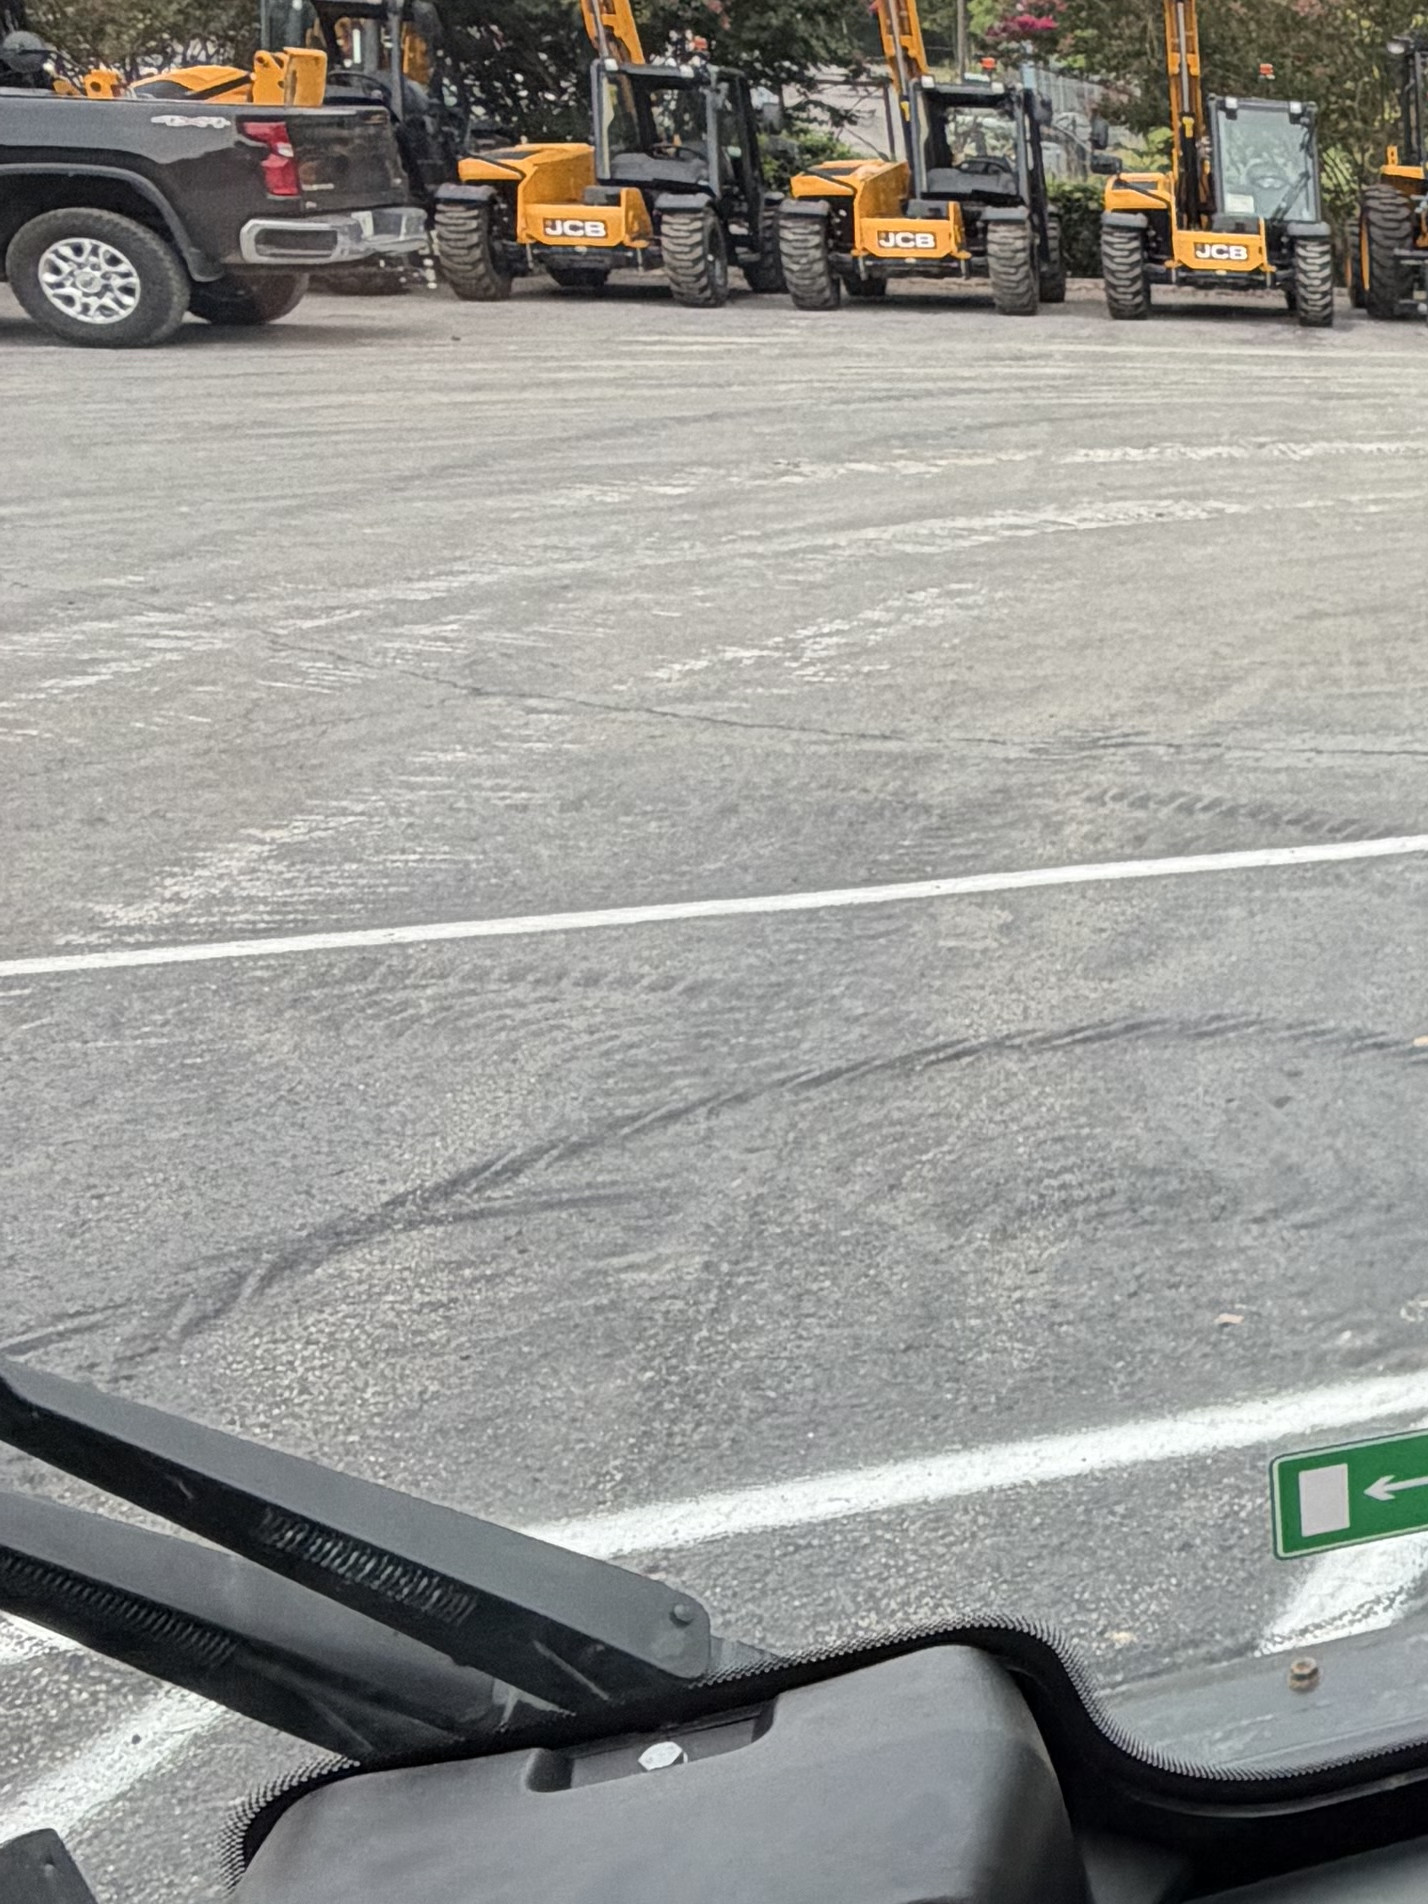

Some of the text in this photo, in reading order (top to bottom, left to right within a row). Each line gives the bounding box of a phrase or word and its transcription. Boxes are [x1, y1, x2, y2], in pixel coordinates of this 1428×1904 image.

[545, 219, 606, 237] JCB
[879, 232, 935, 248] JCB
[1195, 243, 1248, 260] JCB
